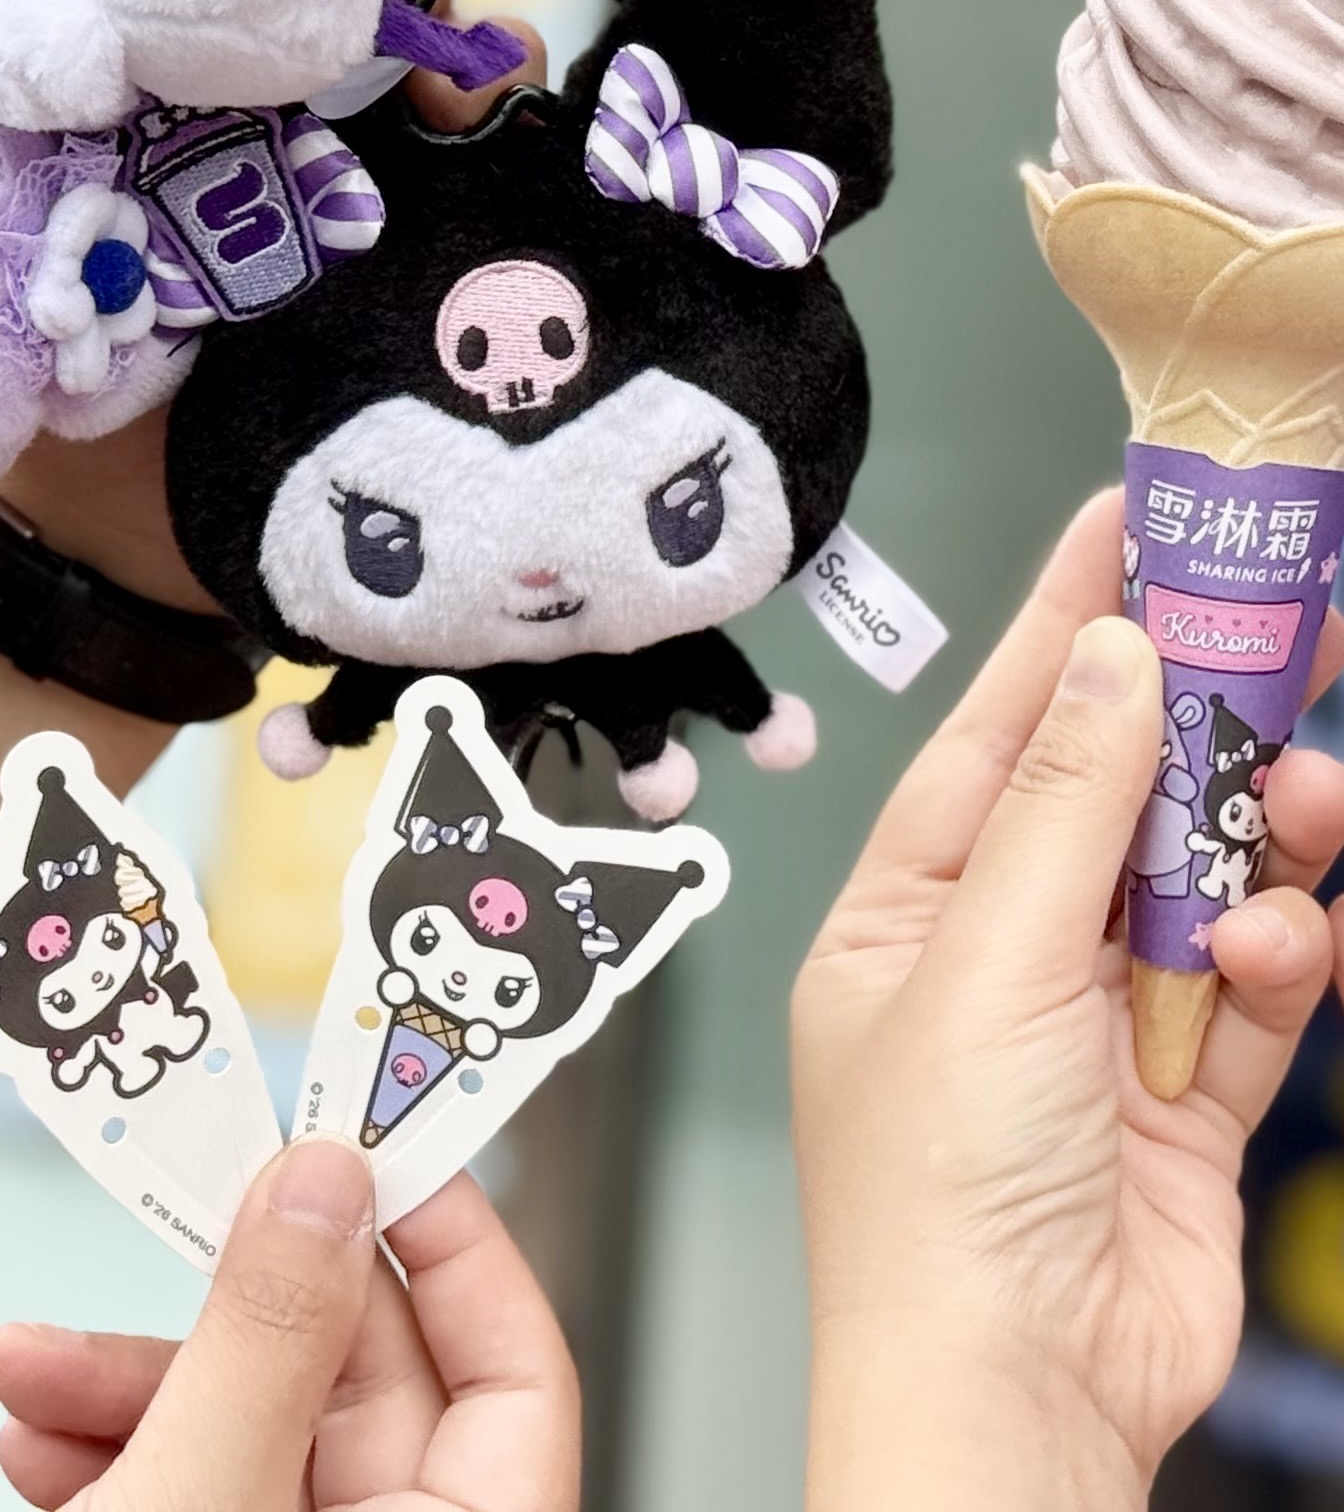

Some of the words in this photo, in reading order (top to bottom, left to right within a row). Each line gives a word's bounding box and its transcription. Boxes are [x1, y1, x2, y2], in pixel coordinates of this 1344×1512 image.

[1145, 479, 1320, 561] 雪淋霜
[1187, 559, 1268, 583] SHARING
[1271, 568, 1295, 583] ICE
[819, 590, 866, 645] LICENSE
[1161, 611, 1280, 654] Kuromi
[170, 1216, 217, 1257] SANRIO
